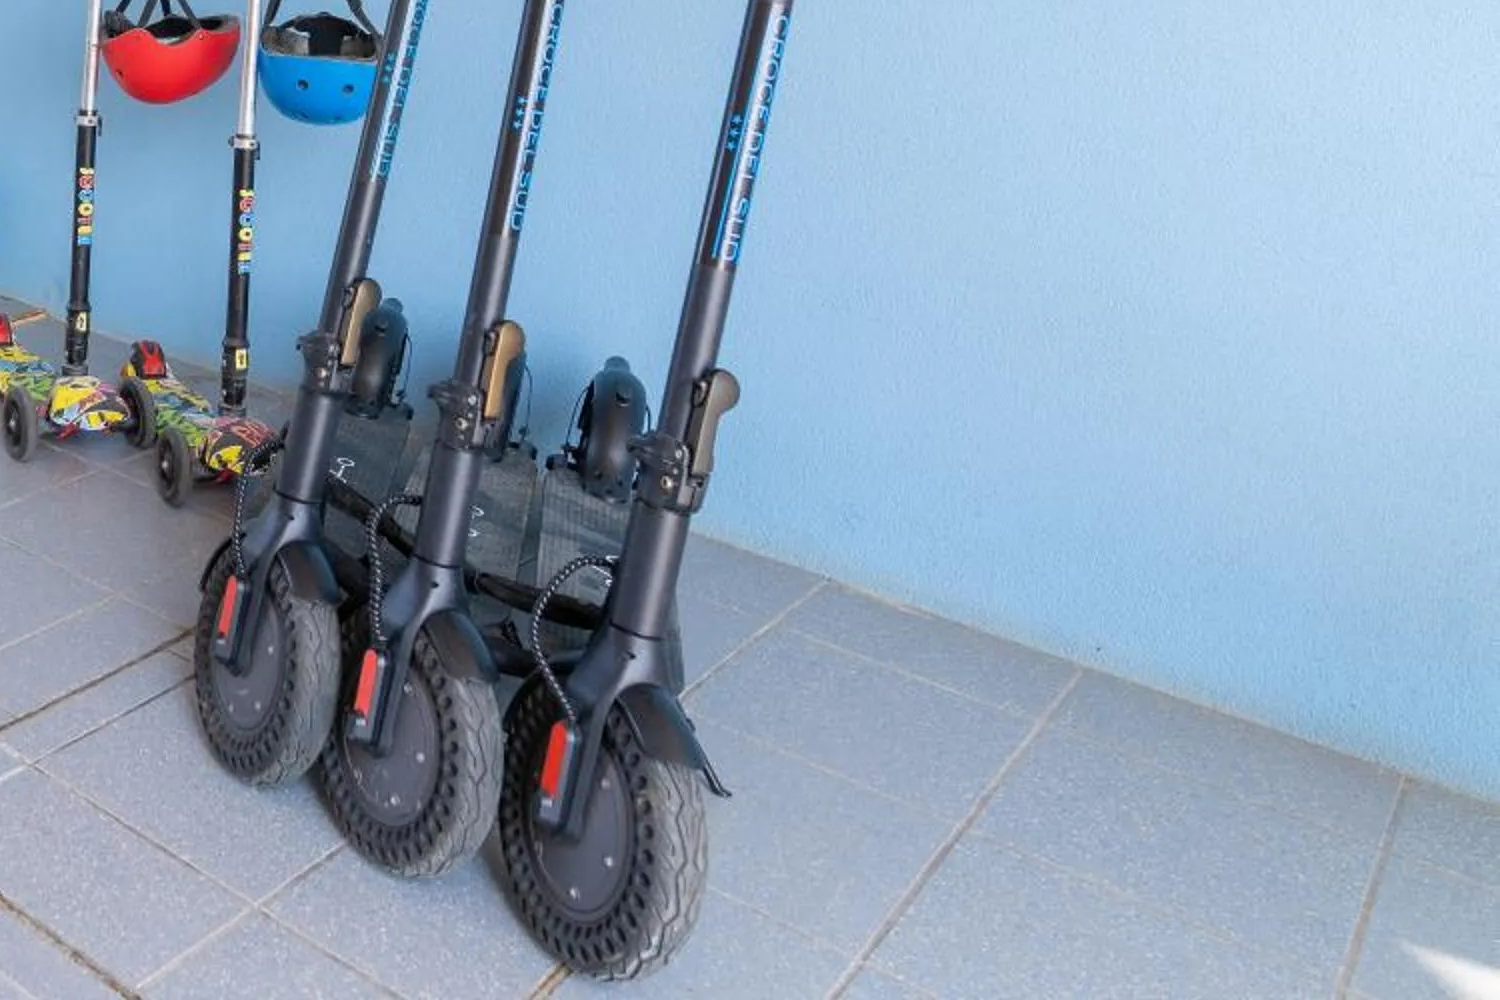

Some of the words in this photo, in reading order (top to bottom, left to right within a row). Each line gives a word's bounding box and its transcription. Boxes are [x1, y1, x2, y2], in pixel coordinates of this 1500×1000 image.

[536, 2, 565, 102] CROCE
[749, 14, 790, 121] CROCE
[523, 109, 545, 167] DEL
[737, 130, 766, 182] DEL
[511, 173, 534, 232] SUD
[720, 197, 752, 264] SUD
